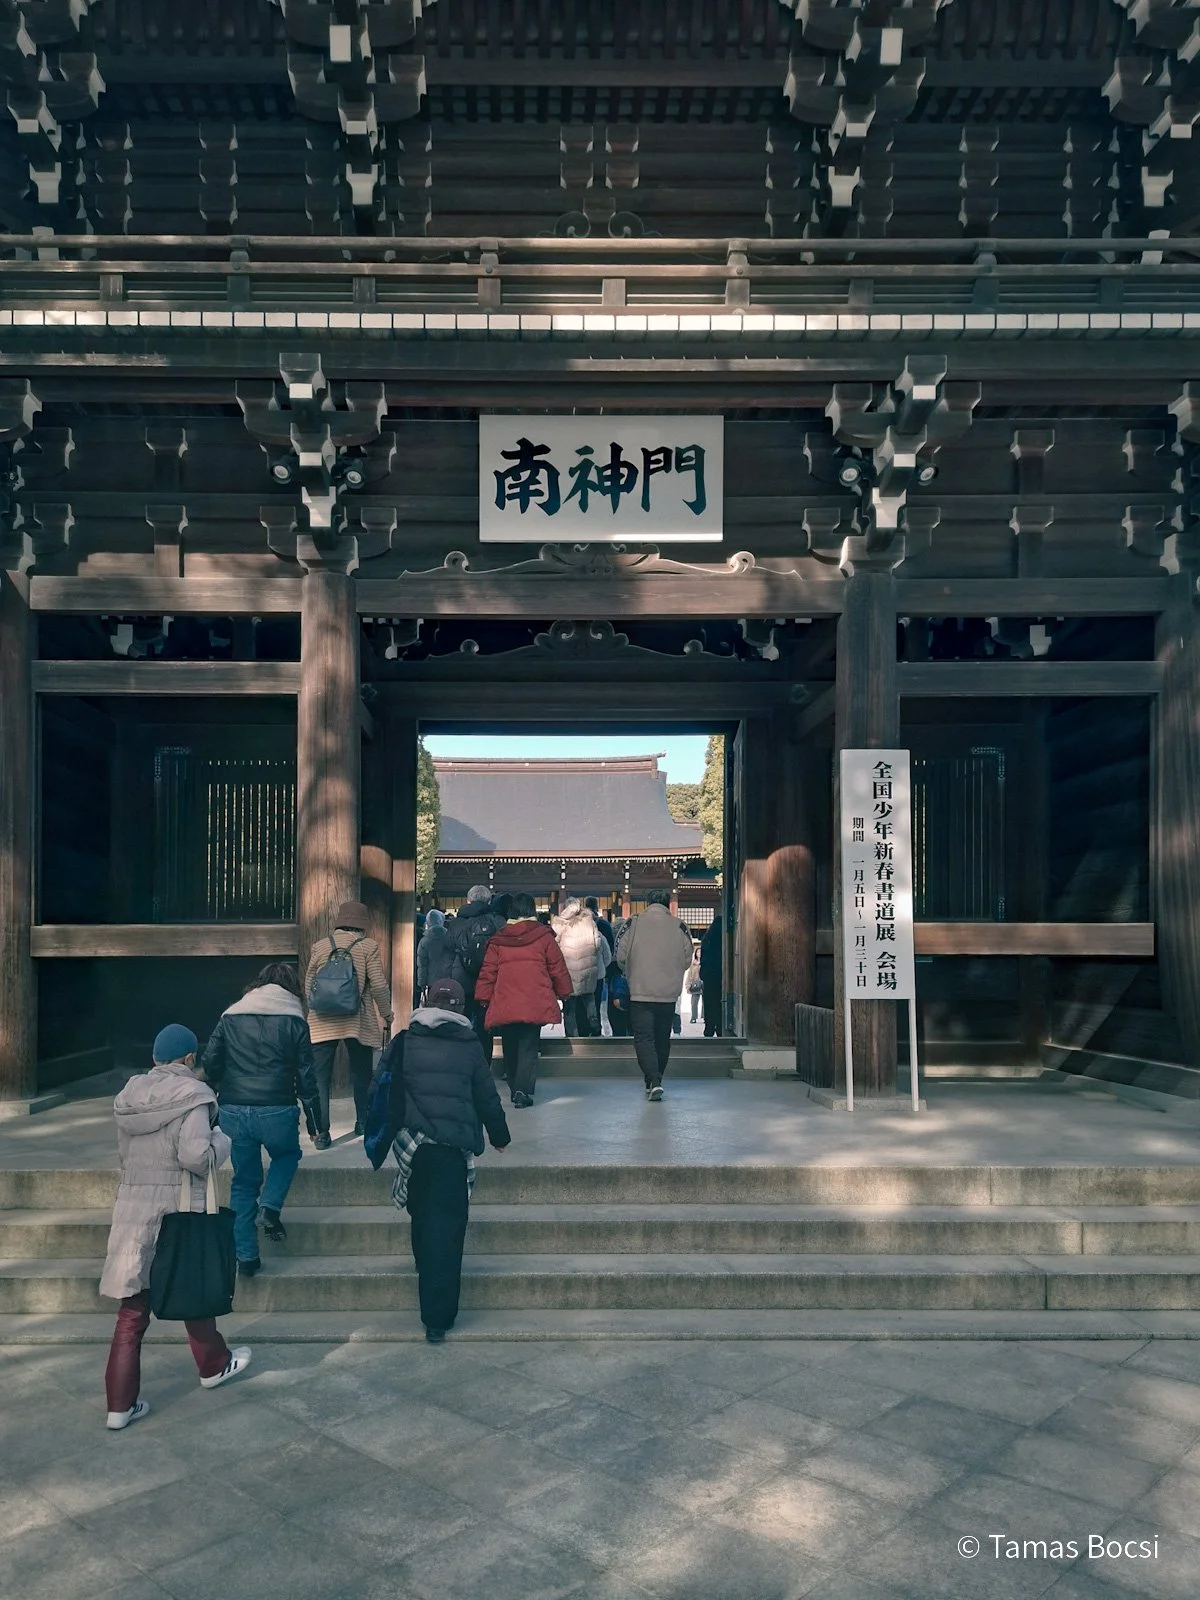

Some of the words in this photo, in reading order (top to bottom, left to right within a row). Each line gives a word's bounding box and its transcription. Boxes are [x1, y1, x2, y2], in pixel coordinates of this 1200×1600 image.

[493, 437, 707, 516] 南神門
[853, 817, 865, 842] 期間
[872, 761, 896, 942] 全国少年新春書道展
[876, 951, 898, 991] 会場
